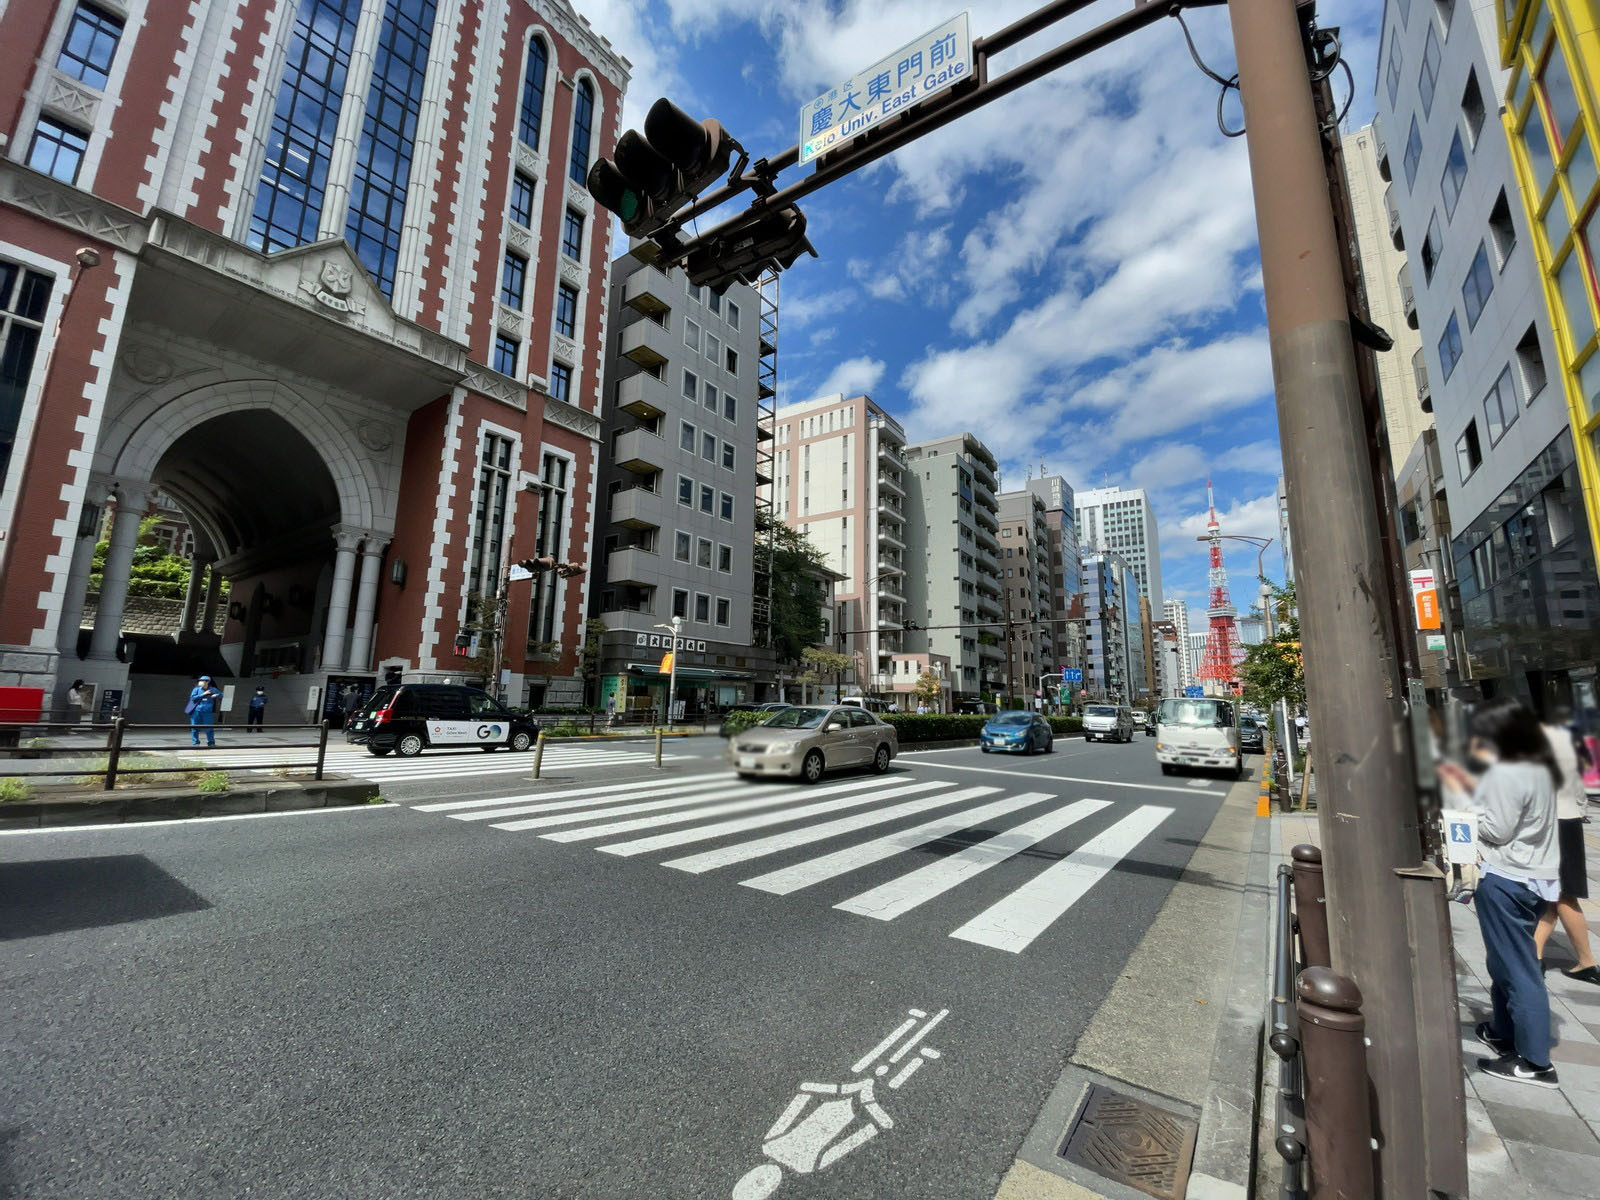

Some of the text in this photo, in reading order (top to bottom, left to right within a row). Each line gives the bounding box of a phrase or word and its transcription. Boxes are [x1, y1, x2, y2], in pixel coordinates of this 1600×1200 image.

[804, 61, 965, 157] Keio Univ. East Gate
[810, 32, 957, 136] 慶大東門前
[828, 79, 853, 101] 港区
